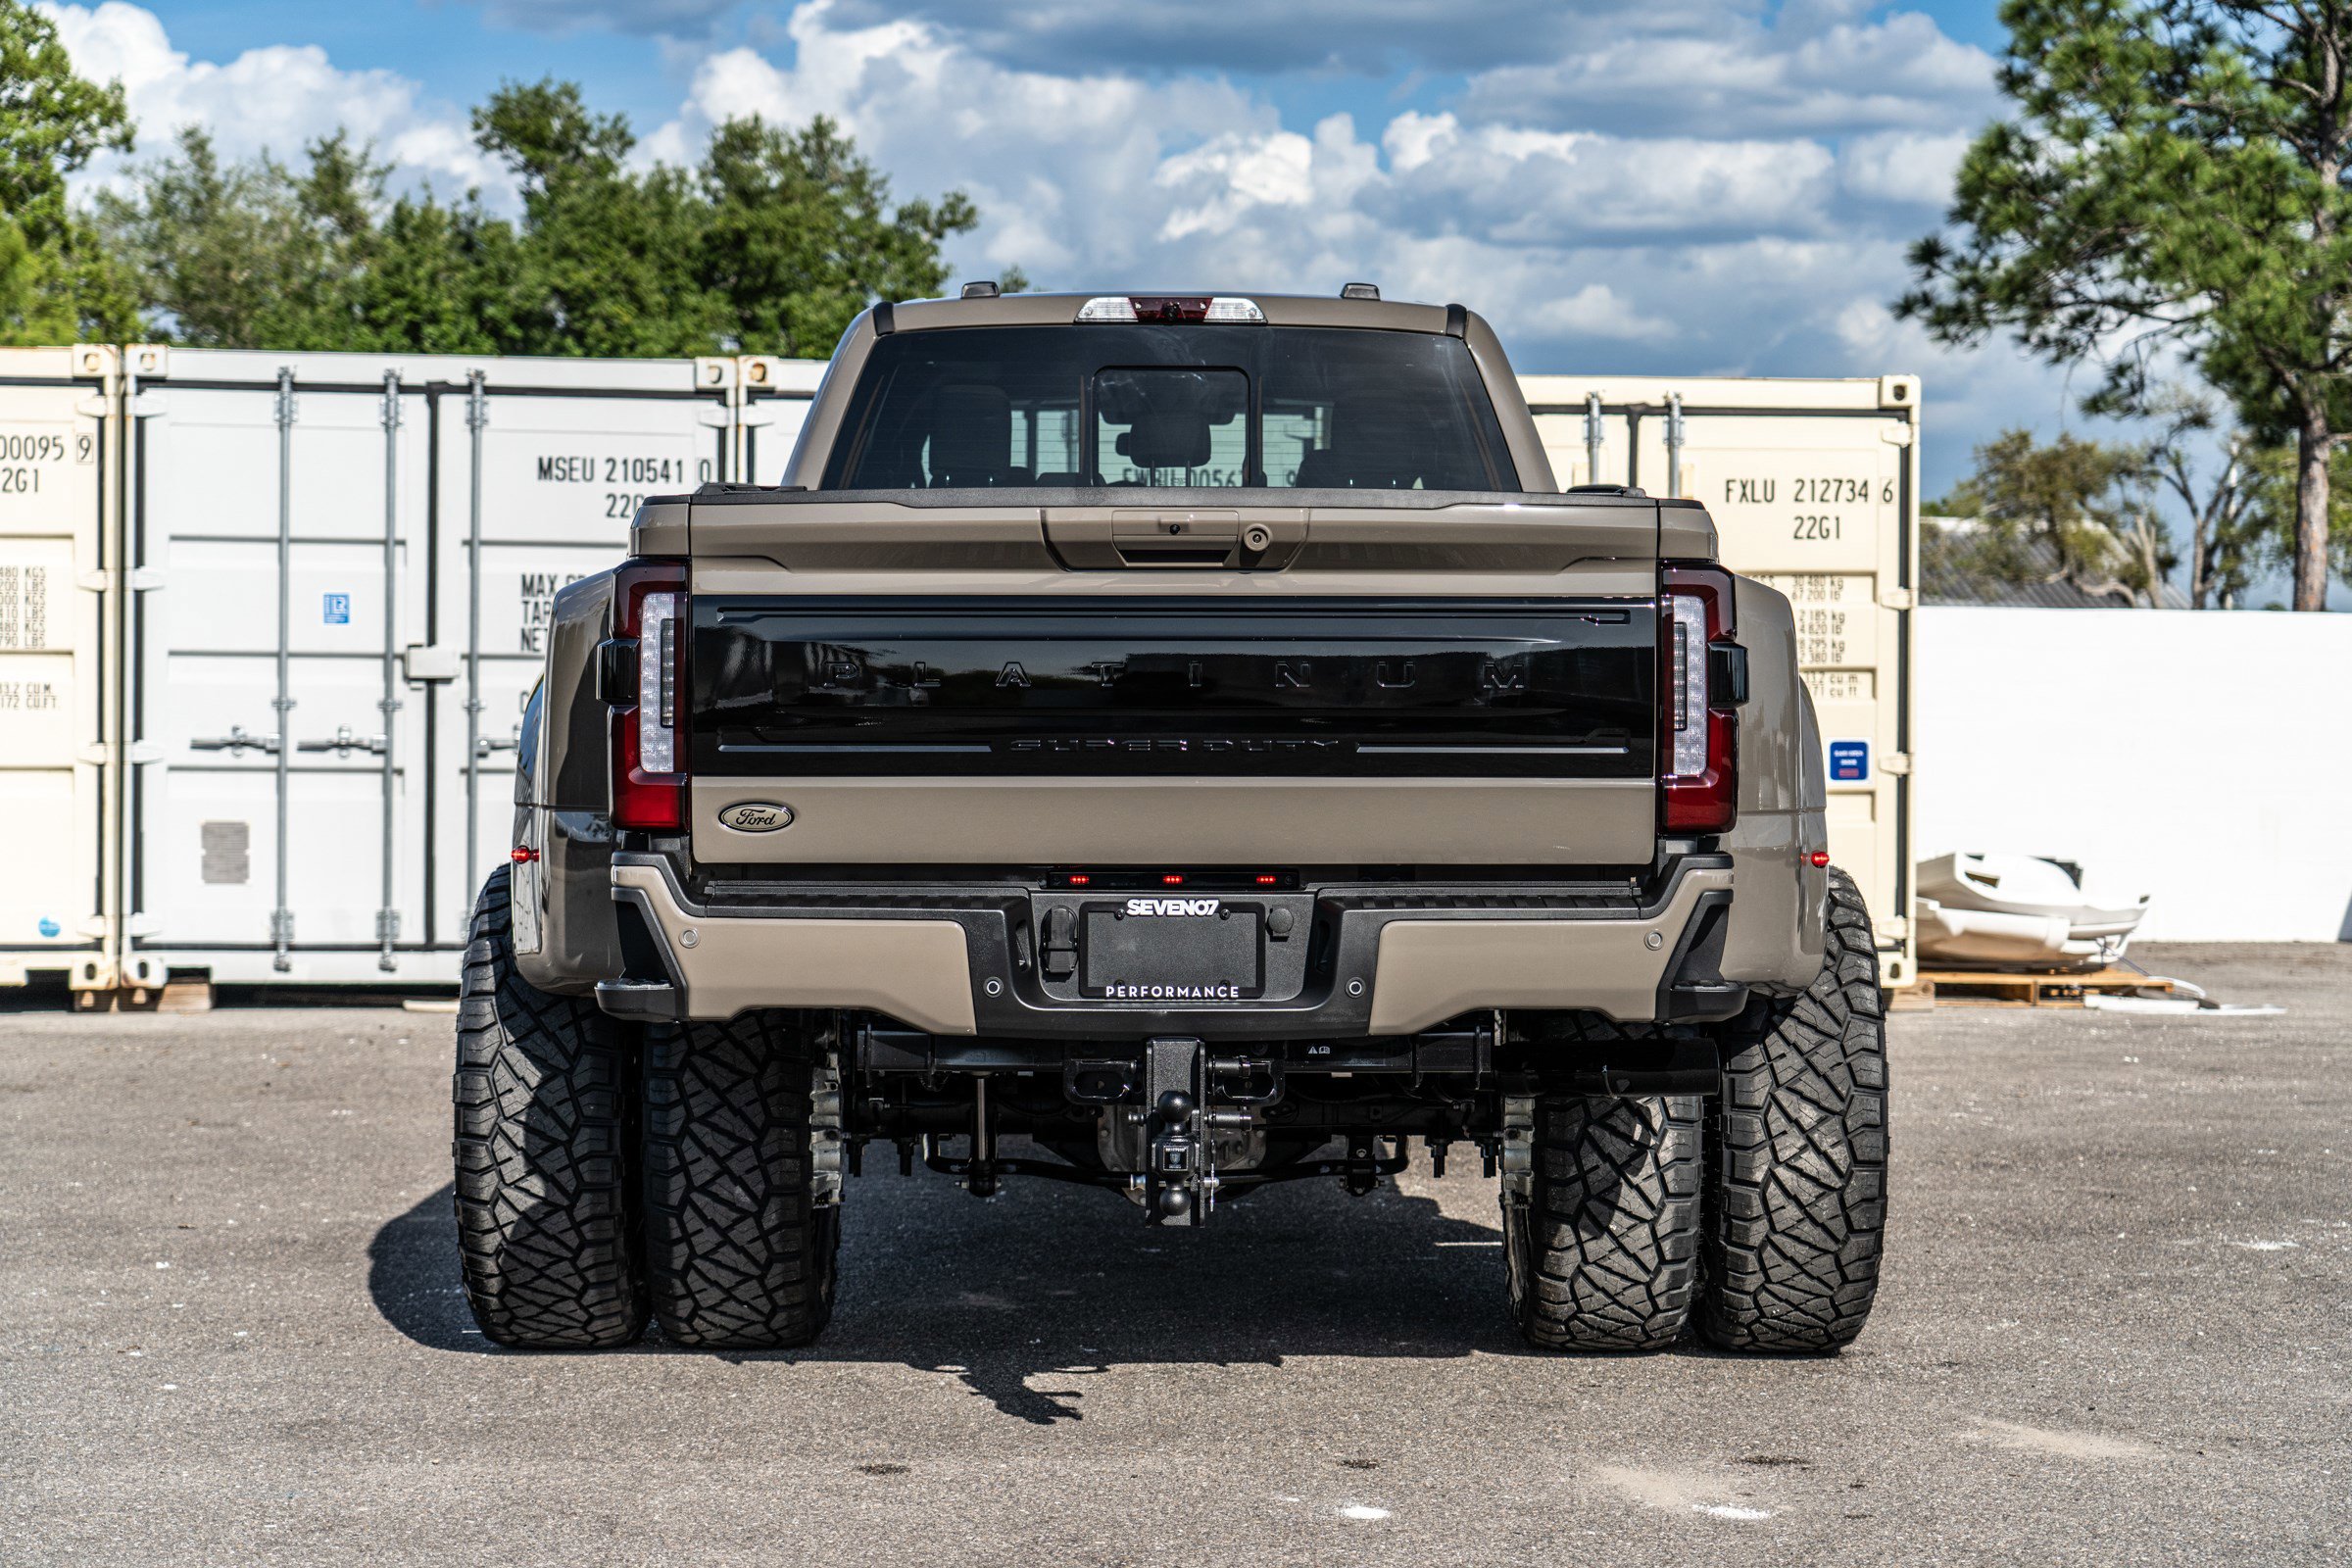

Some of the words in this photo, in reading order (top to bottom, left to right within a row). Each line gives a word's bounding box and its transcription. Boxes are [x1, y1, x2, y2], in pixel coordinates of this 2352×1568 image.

[79, 436, 91, 461] 9
[538, 457, 594, 482] MSEU
[605, 458, 683, 483] 210541
[1726, 479, 1775, 503] FXLU
[1793, 479, 1869, 503] 212734
[1883, 479, 1893, 503] 6
[1793, 515, 1840, 539] 22G1
[521, 574, 558, 598] MAX
[823, 661, 1526, 688] PLATINUM
[1010, 739, 1189, 753] SUPER
[1201, 739, 1340, 753] DUTY
[736, 808, 776, 825] Ford
[1105, 986, 1239, 998] PERFORMANCE
